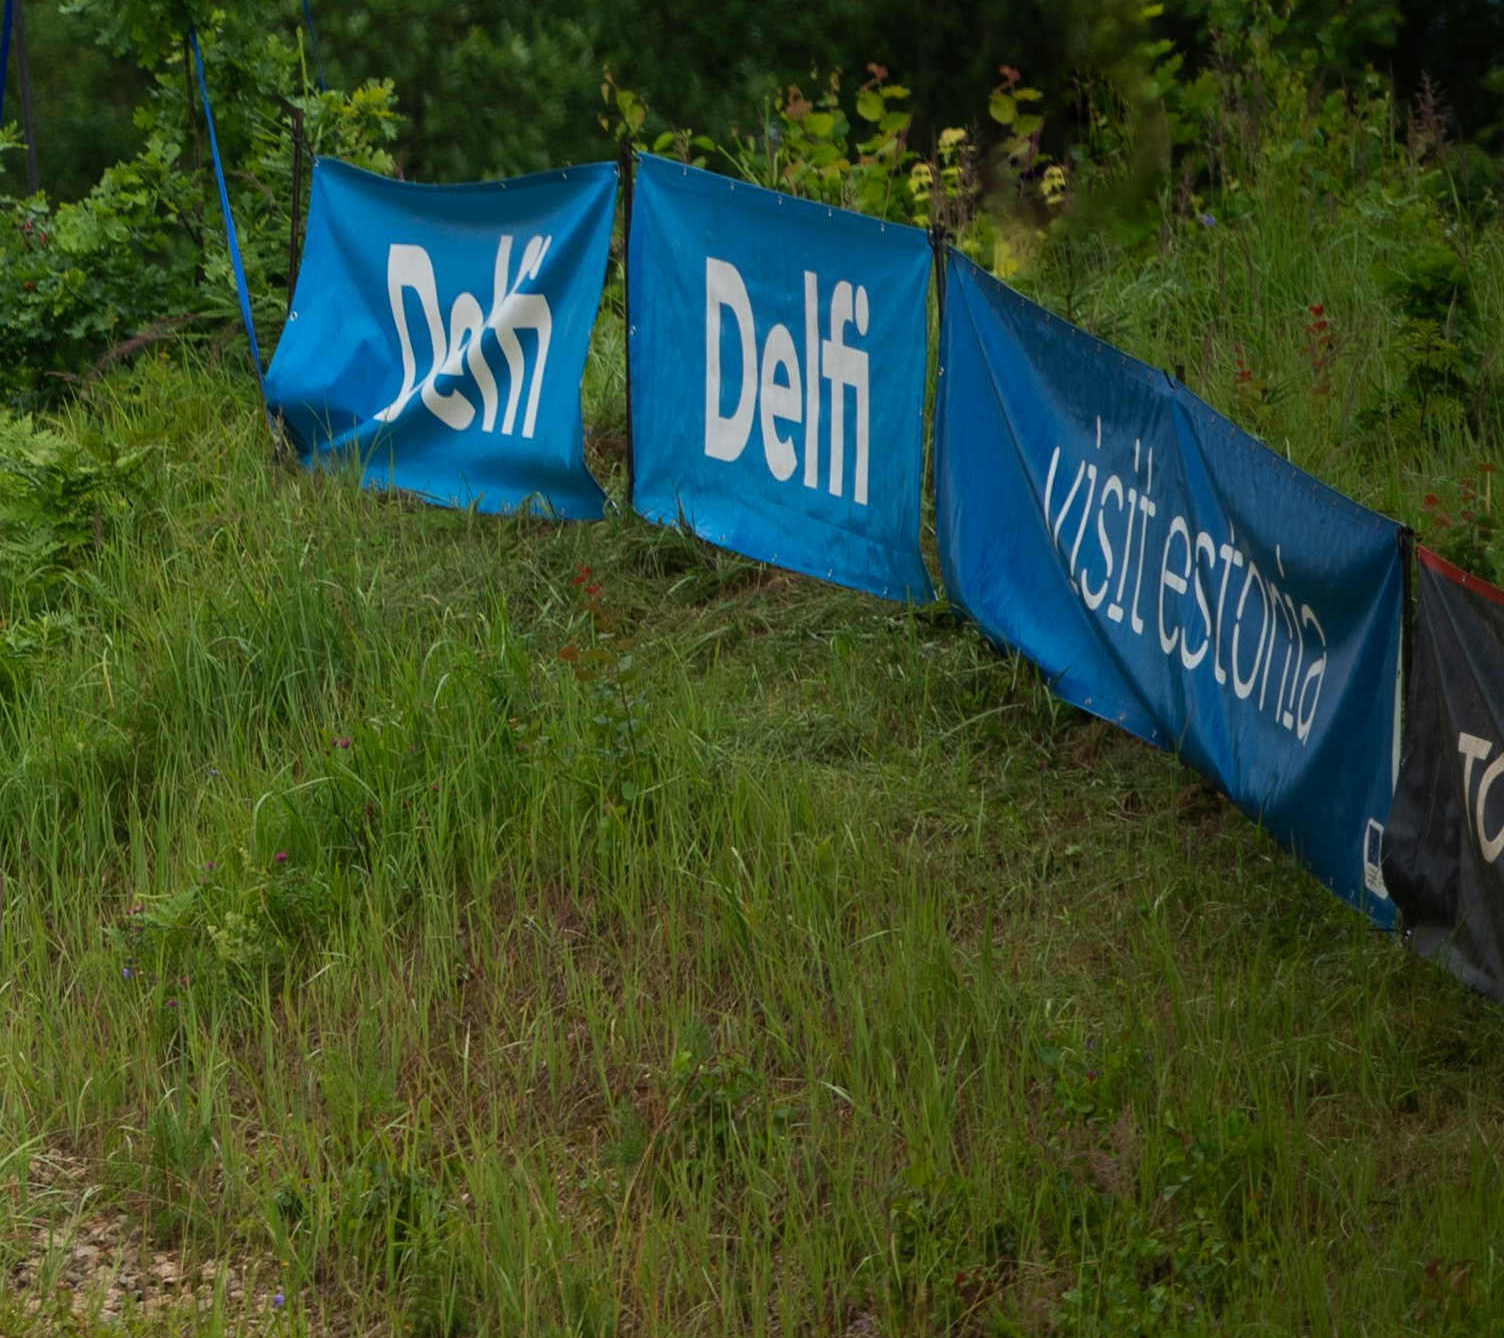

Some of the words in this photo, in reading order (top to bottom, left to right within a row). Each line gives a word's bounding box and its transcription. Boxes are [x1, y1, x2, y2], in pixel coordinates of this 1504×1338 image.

[704, 256, 870, 507] Delfi
[1044, 414, 1157, 635] visit
[1158, 515, 1327, 746] estonia
